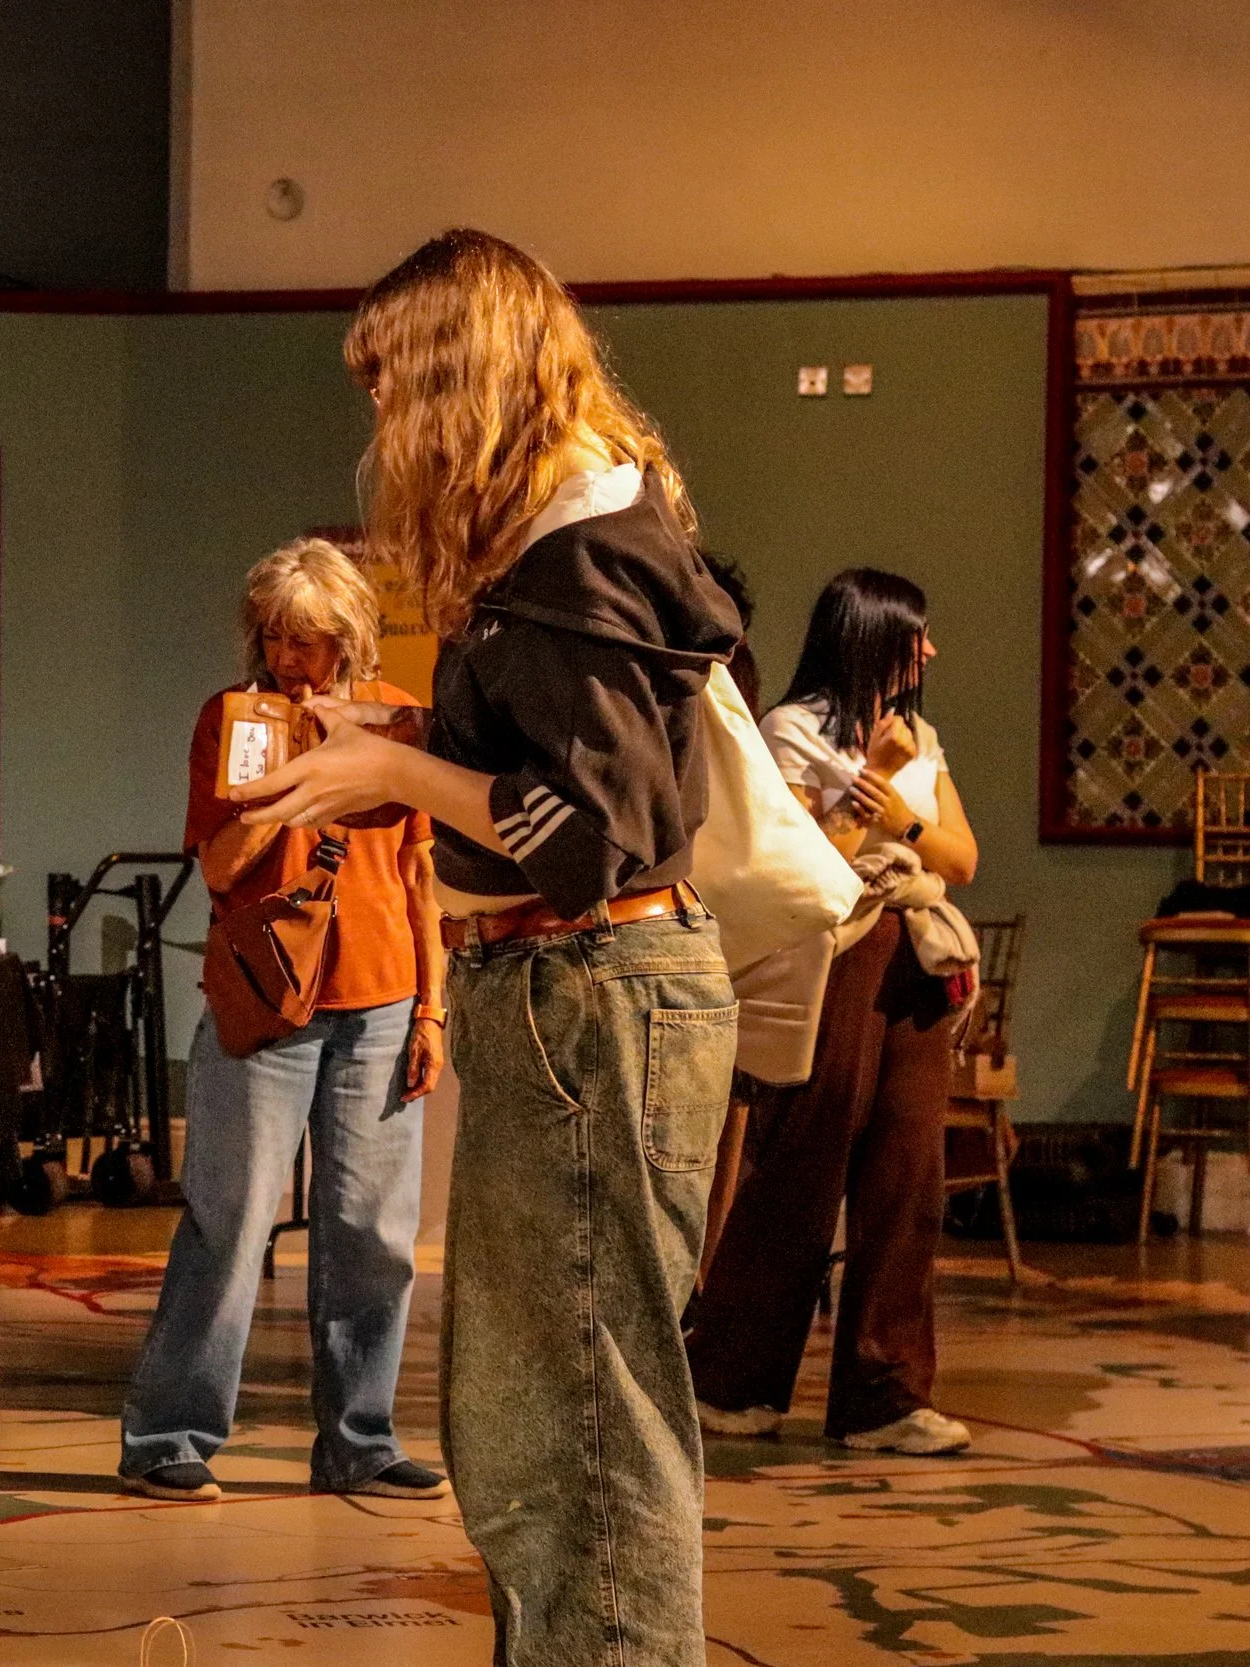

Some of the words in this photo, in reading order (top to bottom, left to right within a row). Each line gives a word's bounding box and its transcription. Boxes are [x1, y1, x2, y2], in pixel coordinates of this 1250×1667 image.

[239, 772, 249, 780] I
[286, 1611, 452, 1620] Barwick
[346, 1618, 463, 1628] Elmet
